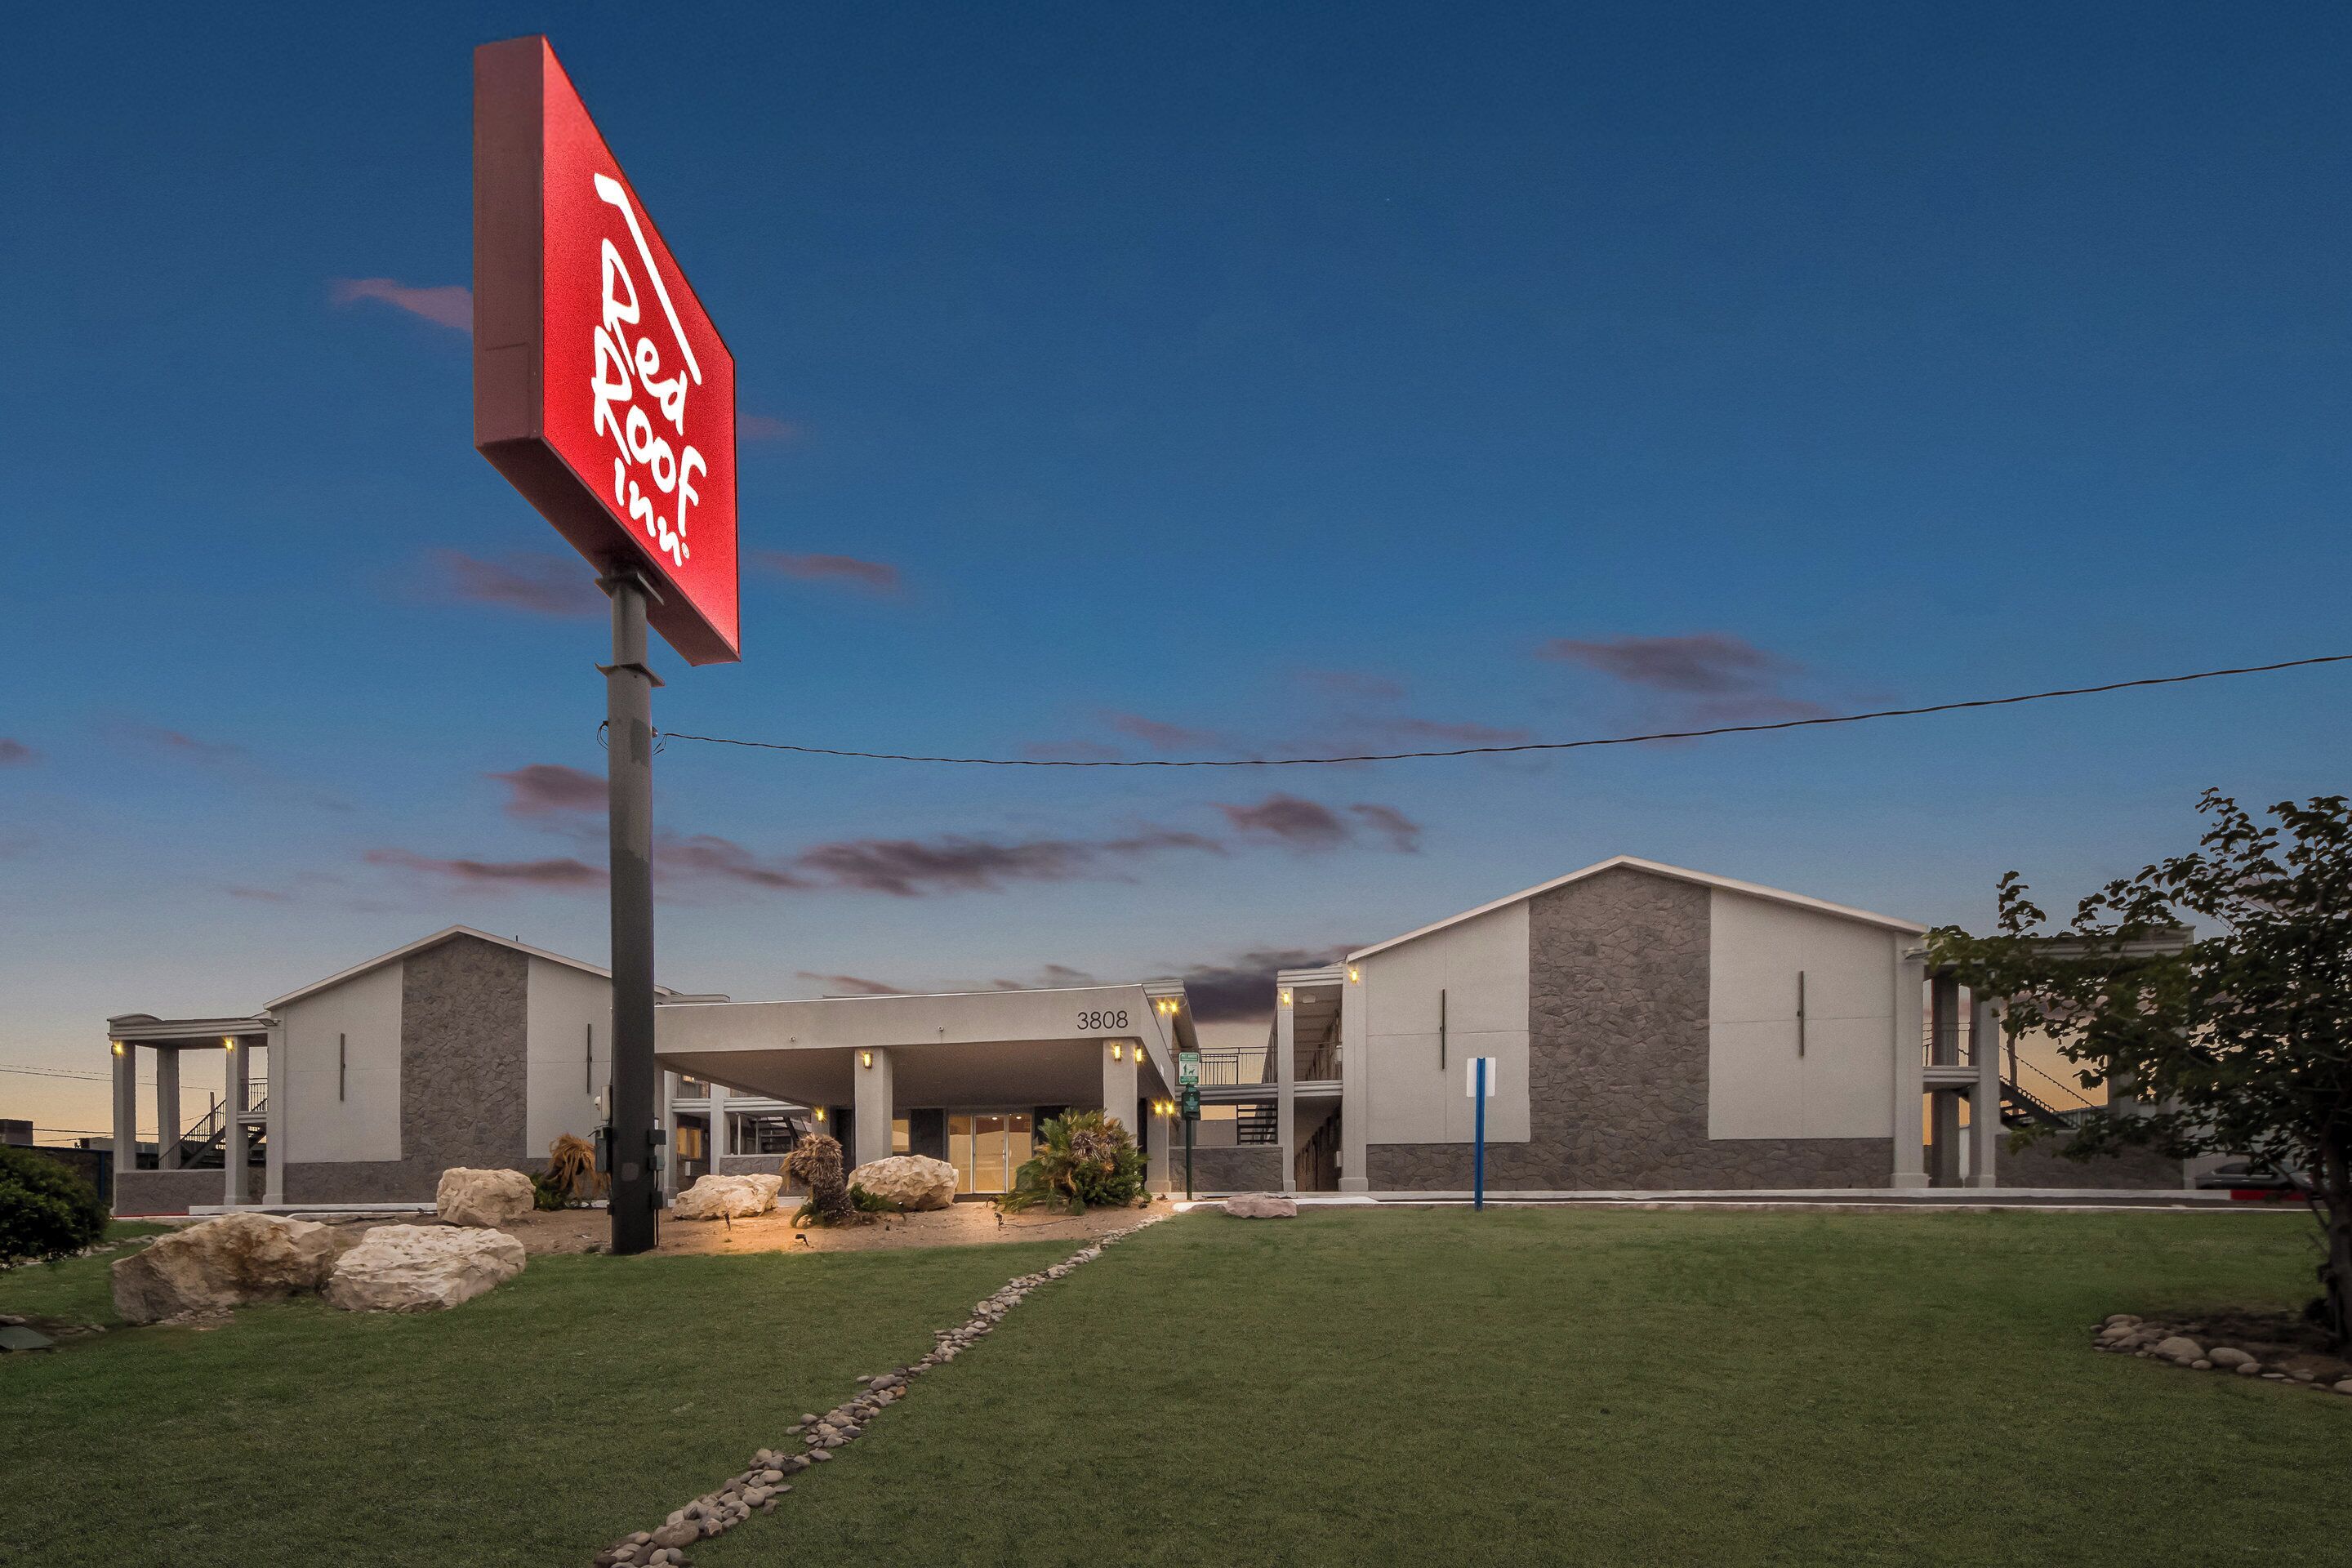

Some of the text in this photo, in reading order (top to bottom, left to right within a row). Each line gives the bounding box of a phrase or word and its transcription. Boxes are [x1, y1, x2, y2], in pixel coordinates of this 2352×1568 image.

[590, 325, 707, 538] Roof
[601, 238, 688, 436] Red
[1076, 1010, 1129, 1030] 3808
